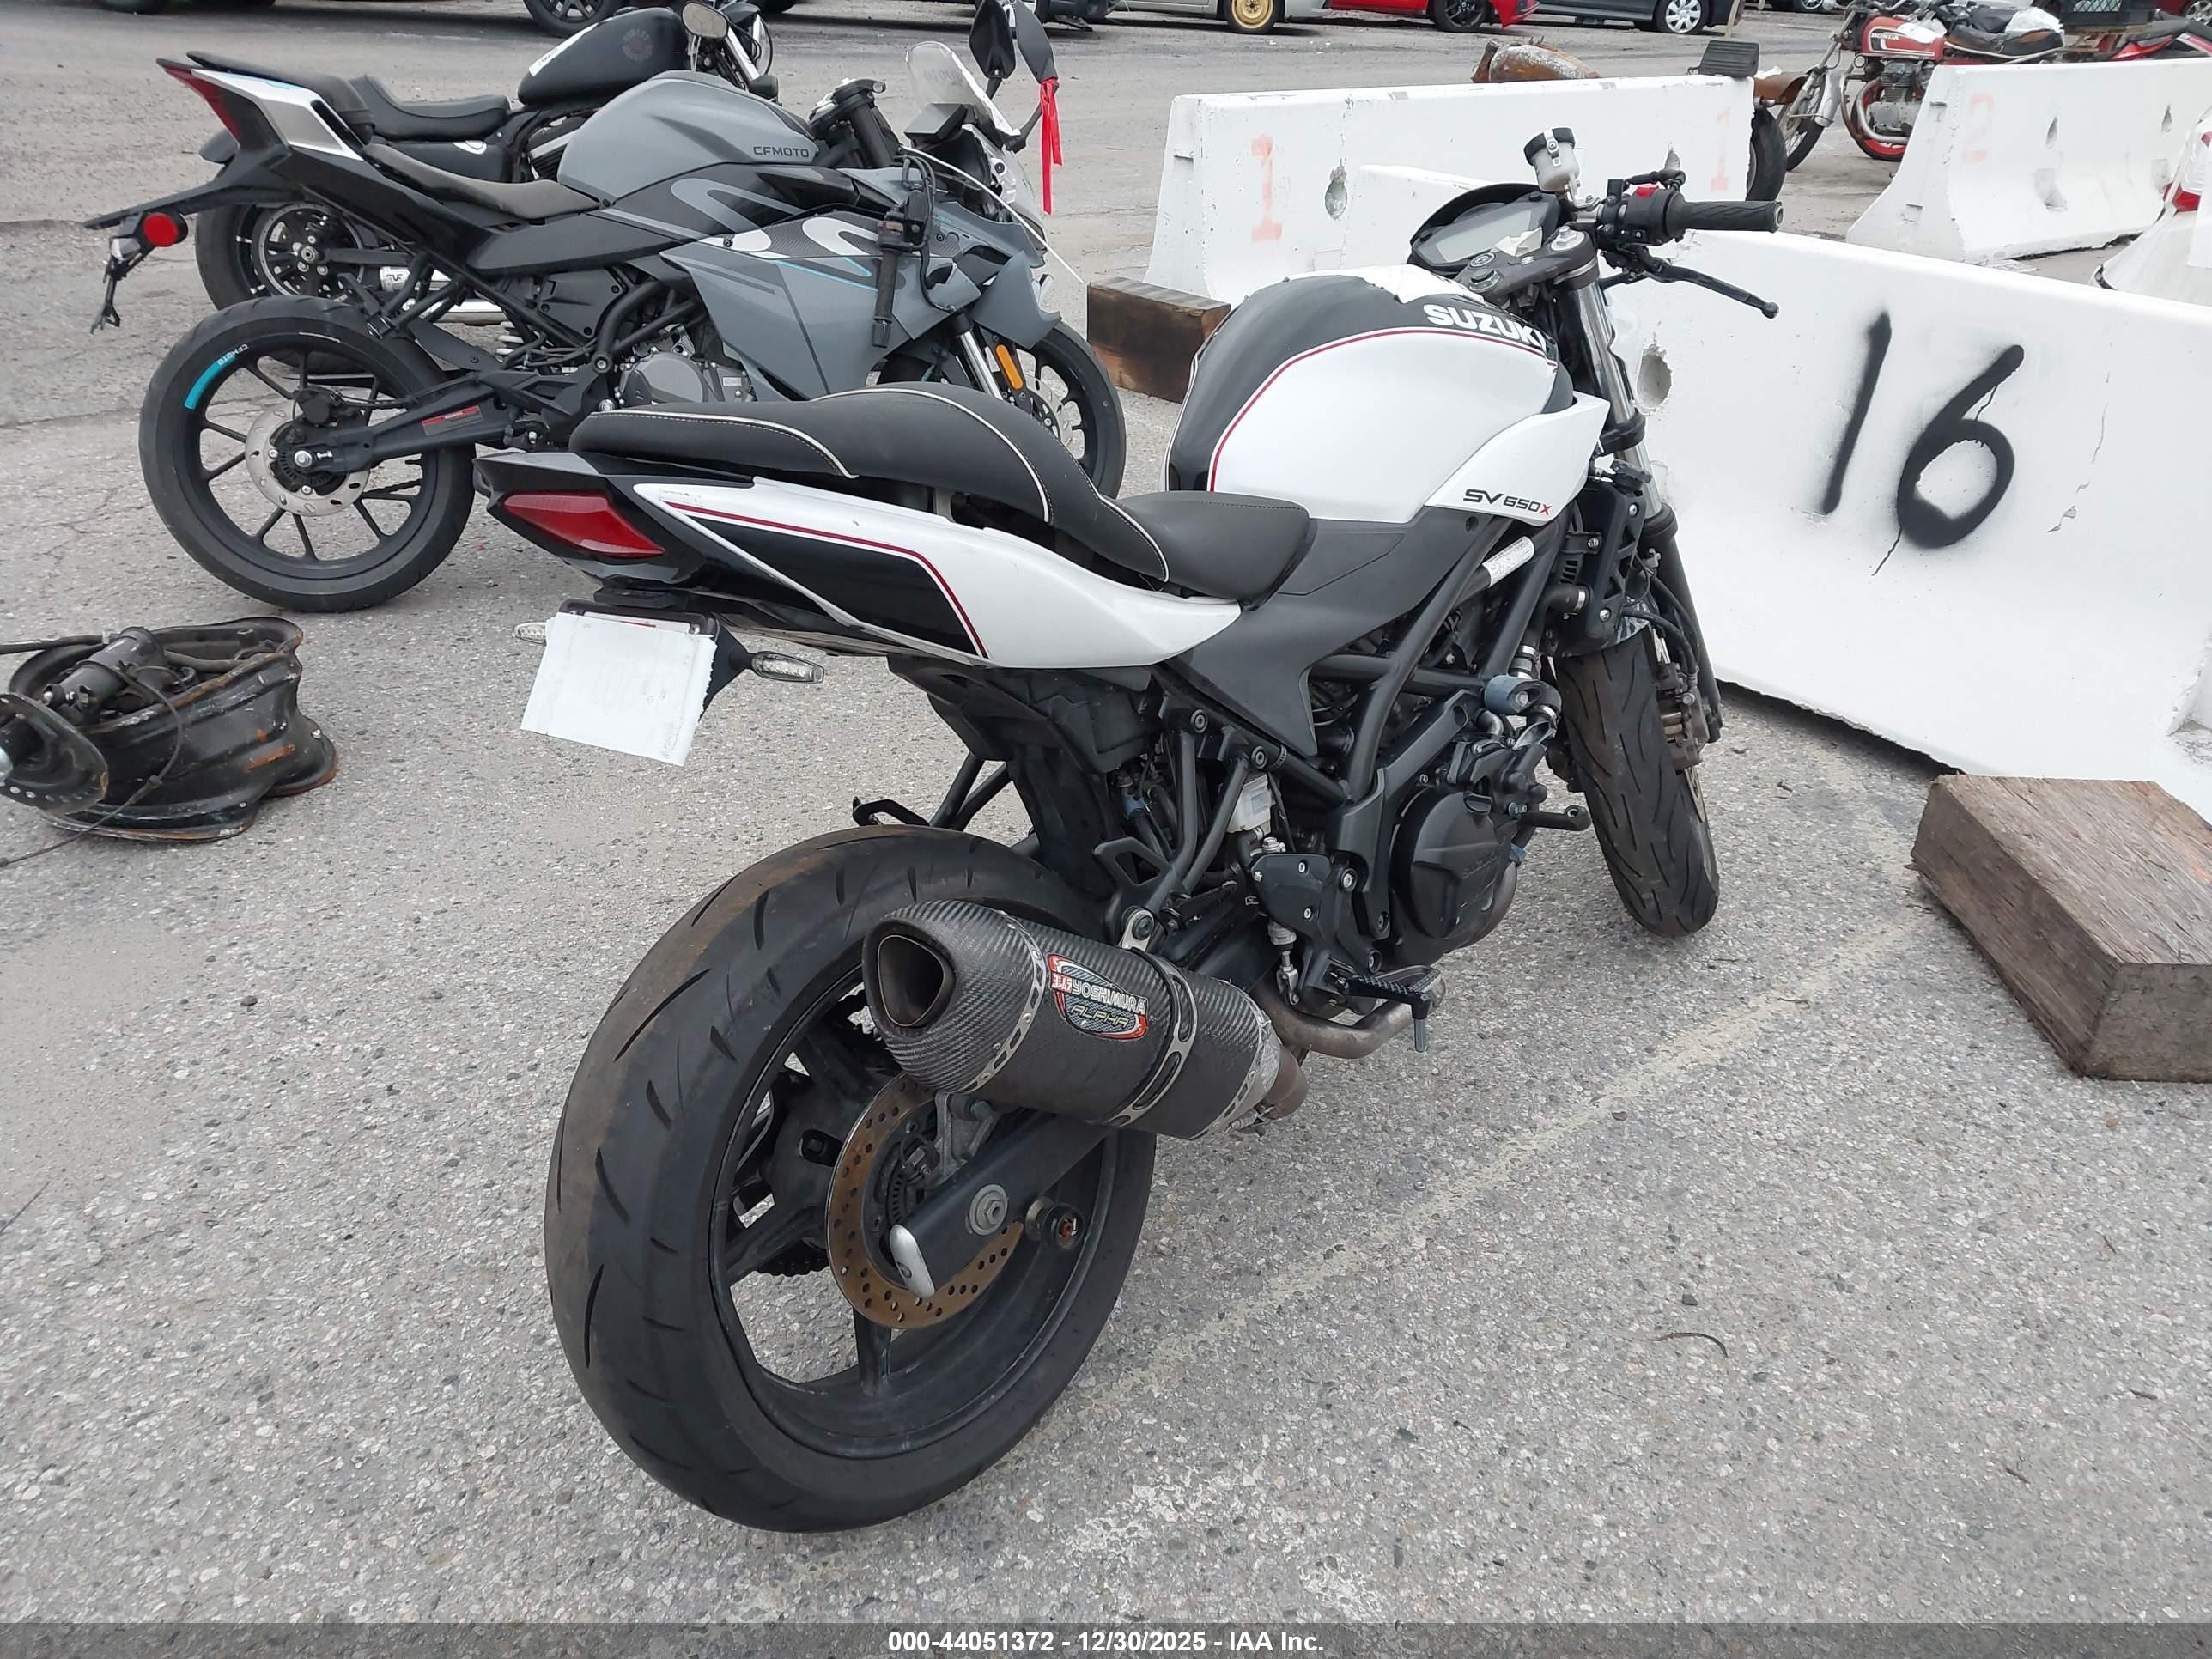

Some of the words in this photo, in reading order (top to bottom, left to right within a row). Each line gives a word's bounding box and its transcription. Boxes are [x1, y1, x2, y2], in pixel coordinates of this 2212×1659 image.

[753, 146, 810, 158] CFMOTO
[1251, 136, 1283, 242] 1
[1423, 303, 1547, 351] SUZUKI
[217, 343, 249, 365] CFMOTO
[1822, 311, 2025, 550] 16
[1070, 1005, 1129, 1028] ALPHA
